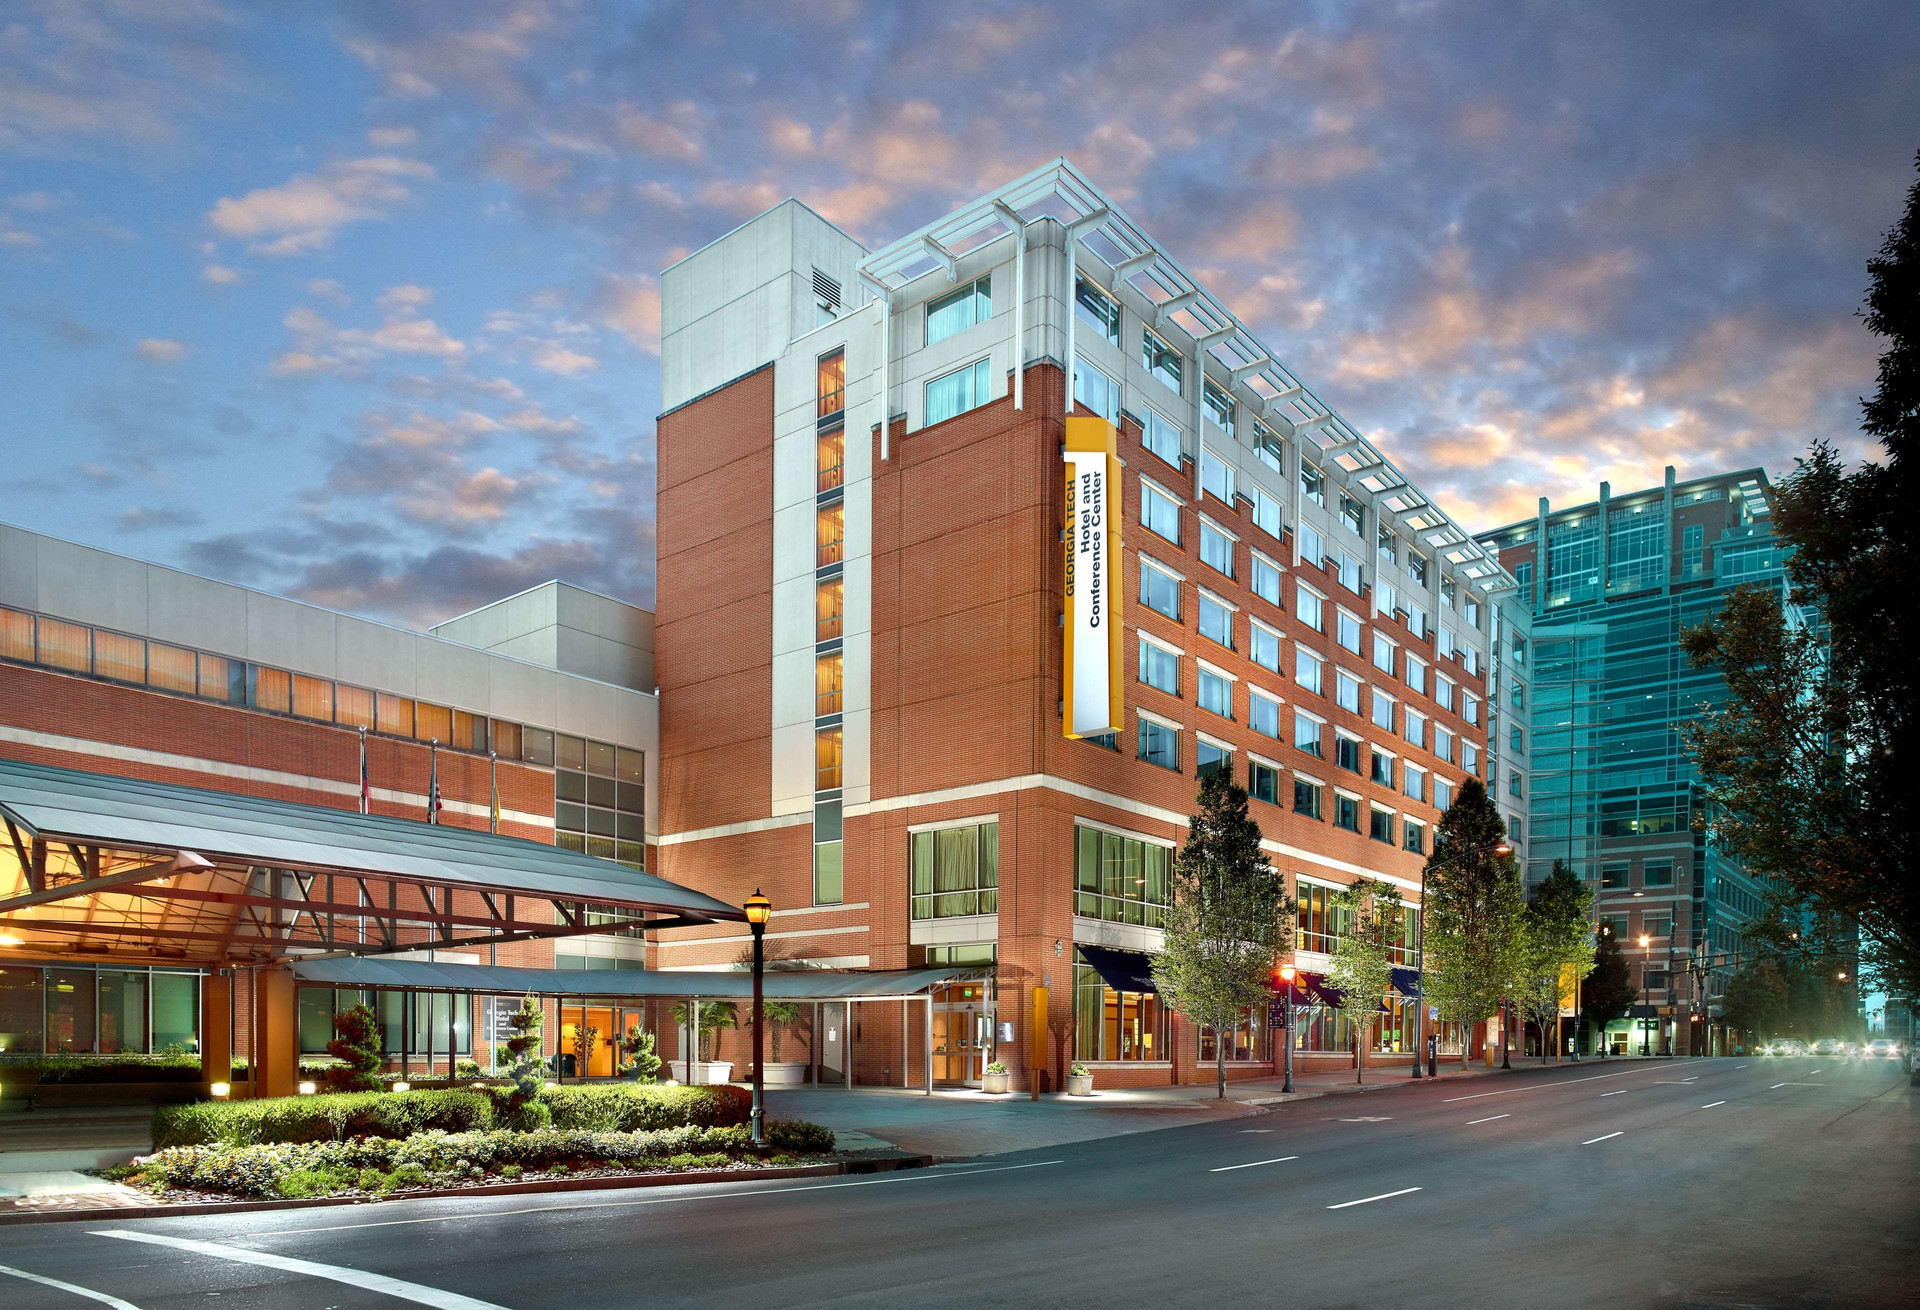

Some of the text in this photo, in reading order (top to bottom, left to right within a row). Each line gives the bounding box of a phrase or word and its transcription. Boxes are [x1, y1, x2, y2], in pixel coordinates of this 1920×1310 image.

[1066, 479, 1075, 597] GEORGIA TECH
[1081, 473, 1090, 553] Hotel and
[1090, 471, 1101, 628] Conference Center
